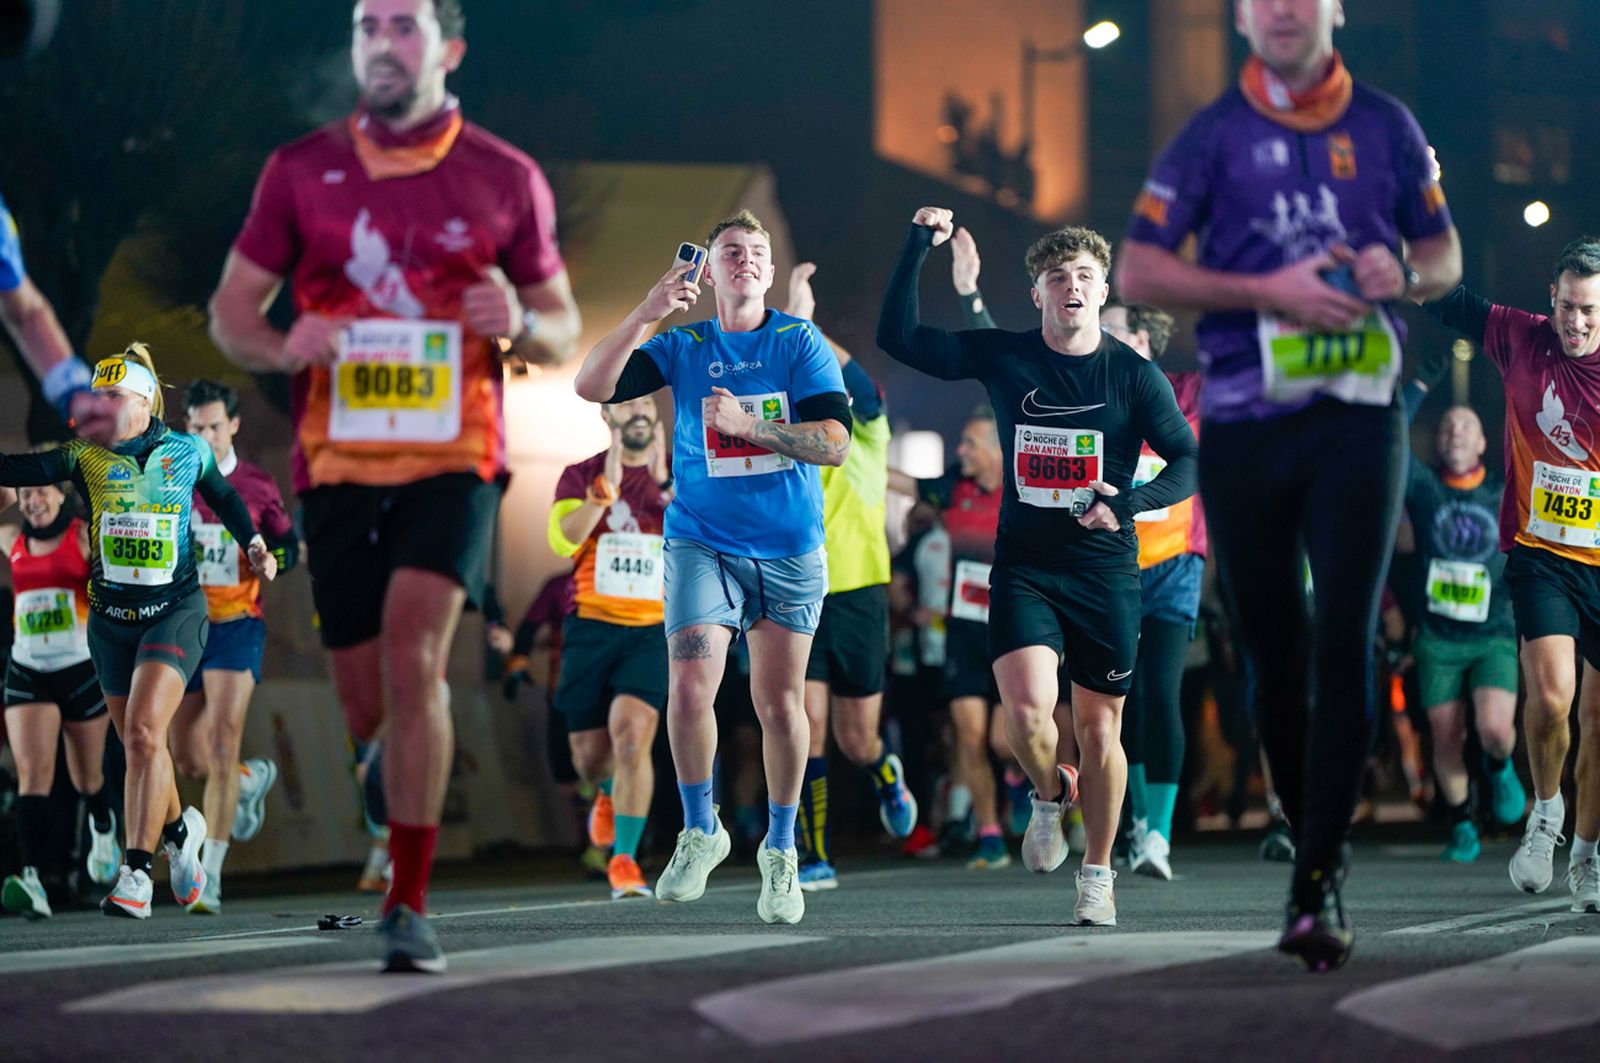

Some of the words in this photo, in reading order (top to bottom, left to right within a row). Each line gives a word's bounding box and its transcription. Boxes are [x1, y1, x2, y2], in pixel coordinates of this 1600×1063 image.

[97, 362, 124, 382] UFF
[354, 365, 434, 398] 9083
[1033, 435, 1057, 445] NOCHE
[1058, 437, 1068, 446] DE
[1549, 424, 1571, 447] 43
[1023, 444, 1040, 454] SAN
[1028, 455, 1087, 481] 9663
[1543, 490, 1593, 521] 7433
[112, 537, 164, 561] 3583
[610, 557, 654, 576] 4449
